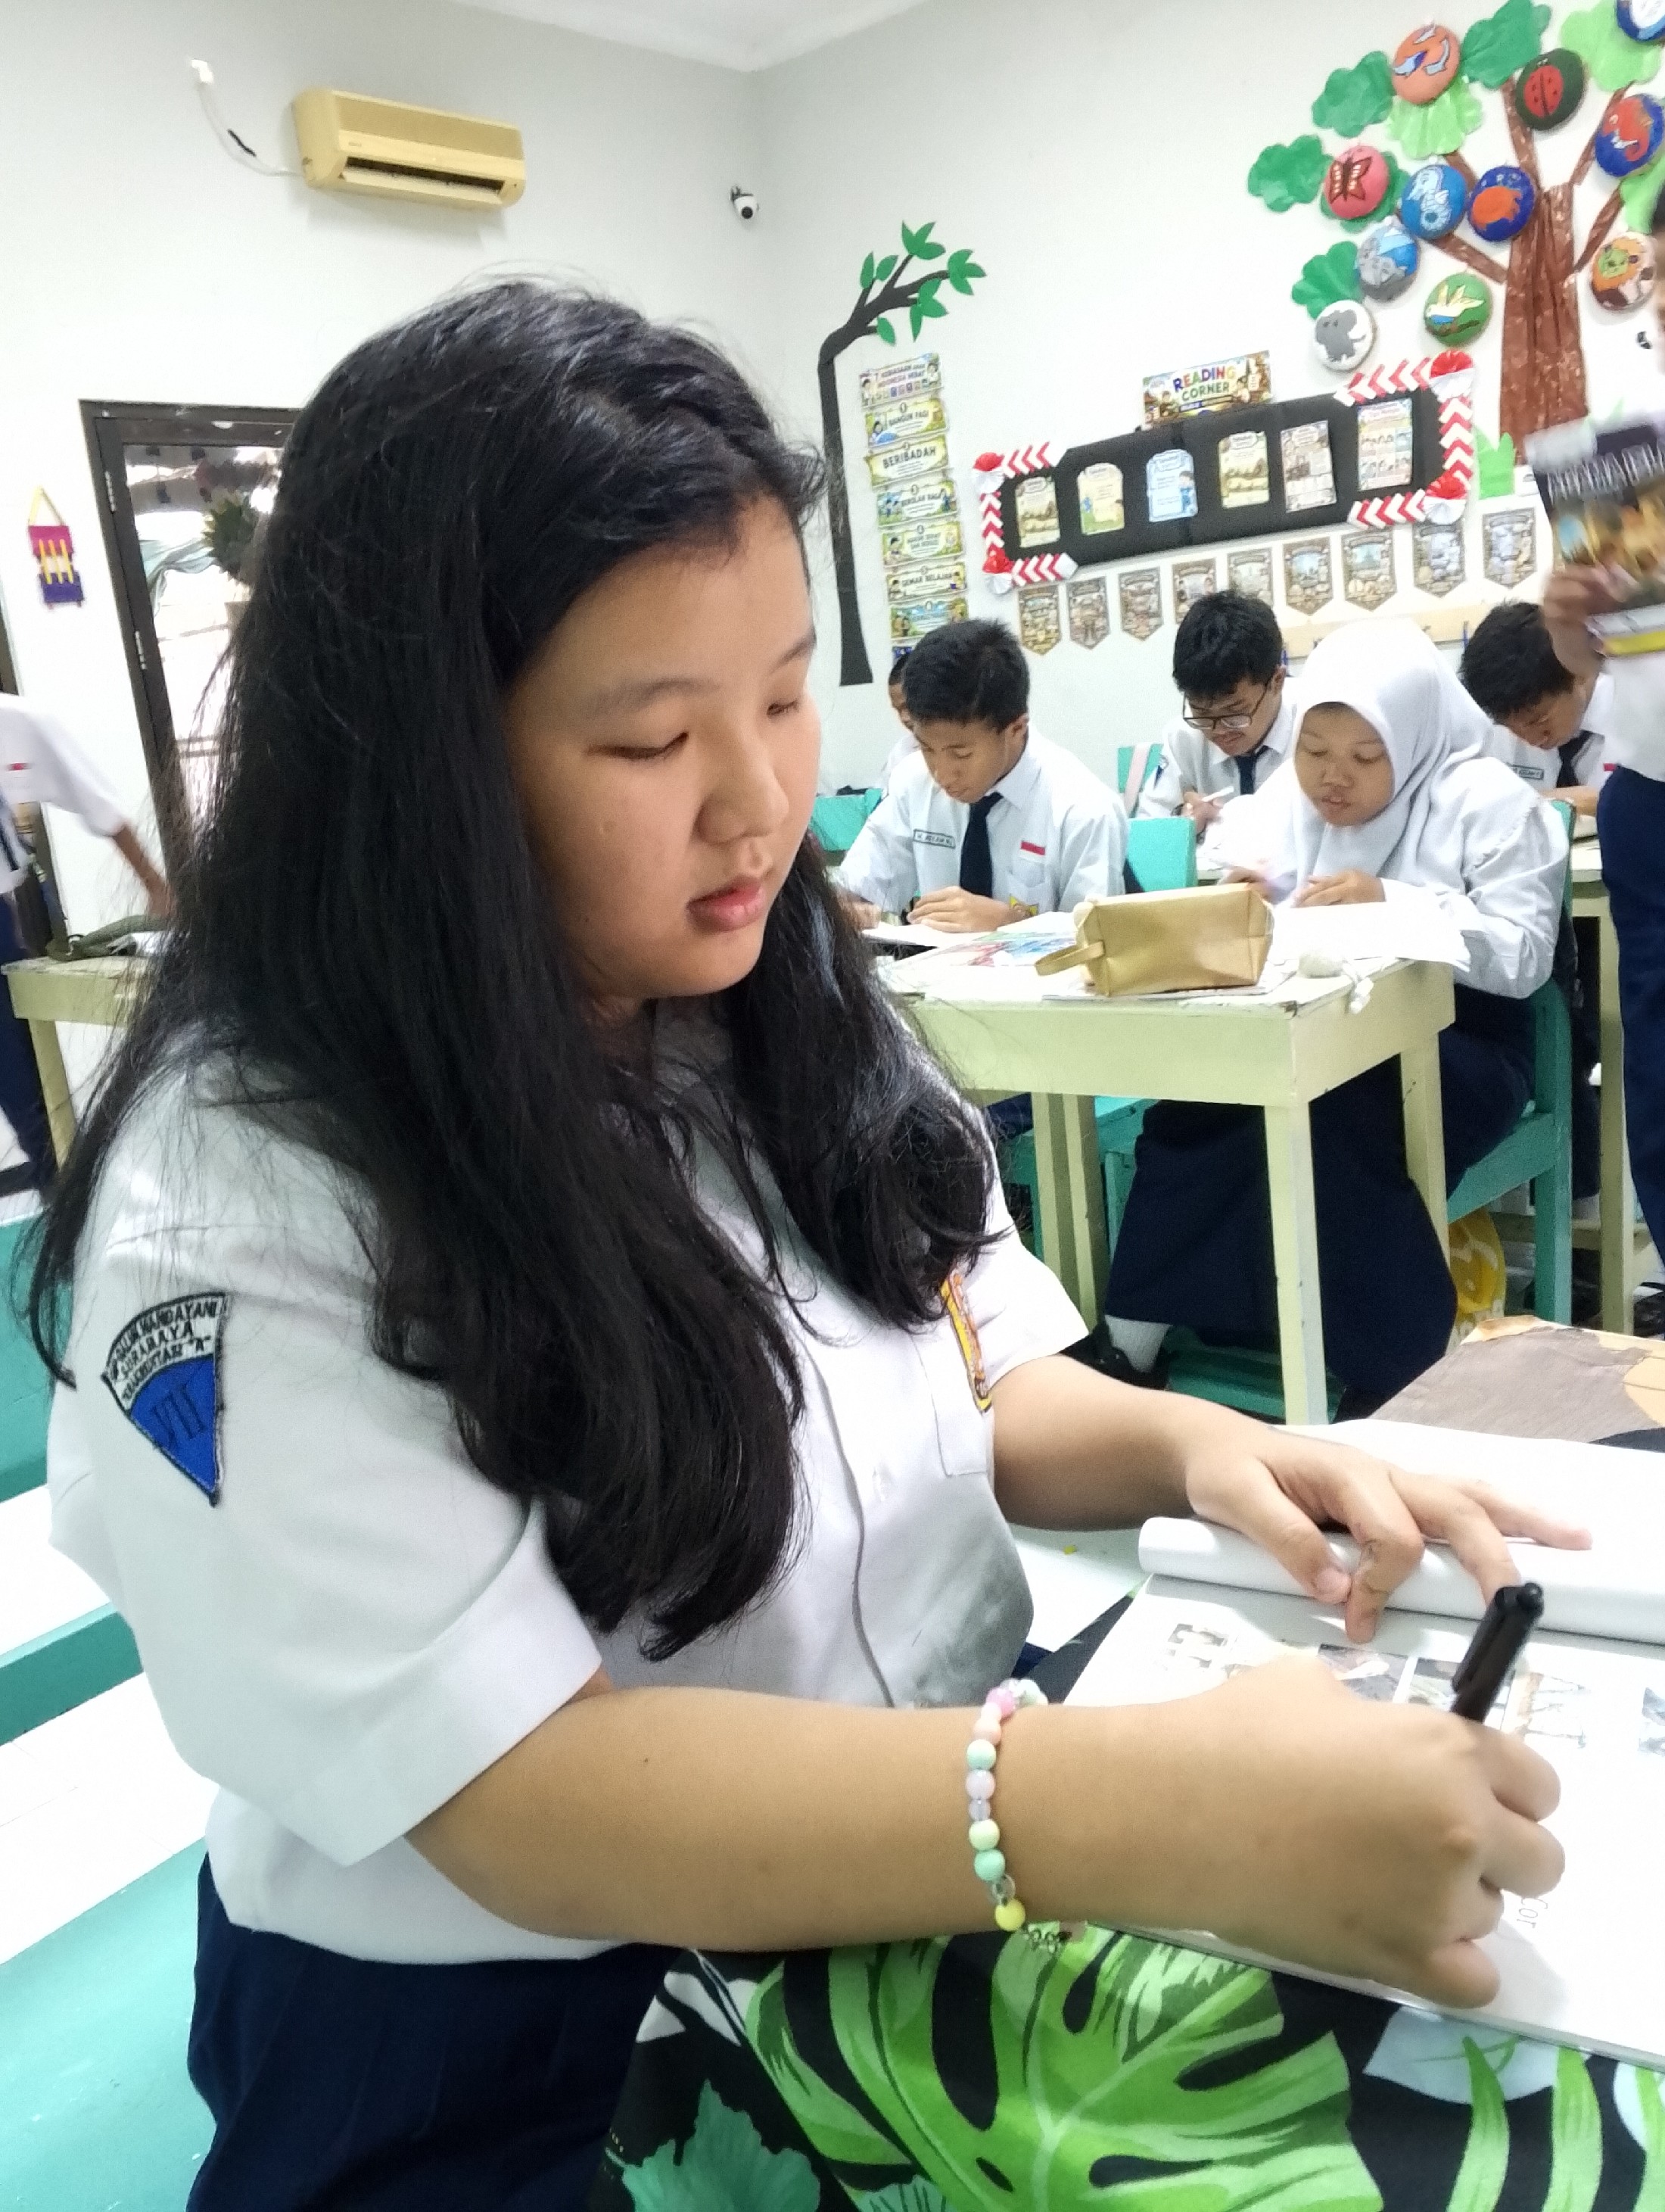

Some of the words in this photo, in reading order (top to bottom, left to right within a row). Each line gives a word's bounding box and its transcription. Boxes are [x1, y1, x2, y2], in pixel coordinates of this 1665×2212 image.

[1172, 365, 1237, 392] READING
[1181, 381, 1230, 401] CORNER
[883, 447, 936, 468] BERIBADAH
